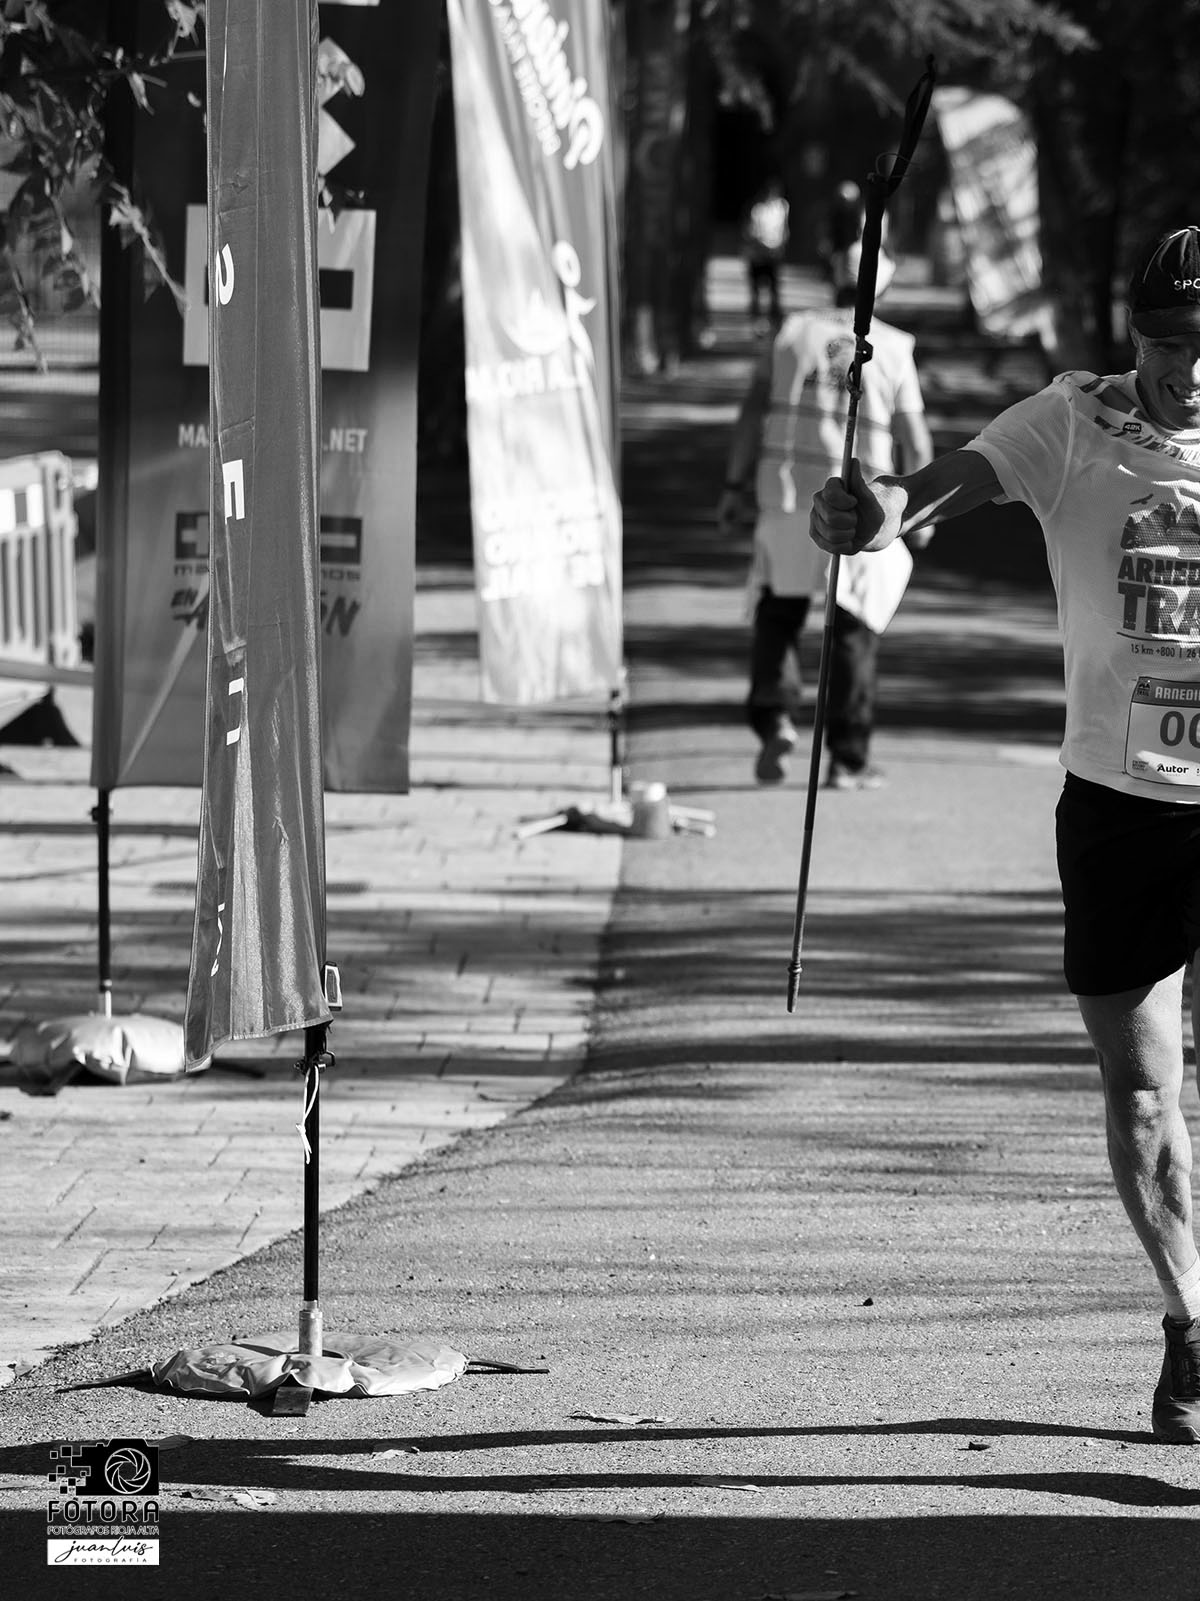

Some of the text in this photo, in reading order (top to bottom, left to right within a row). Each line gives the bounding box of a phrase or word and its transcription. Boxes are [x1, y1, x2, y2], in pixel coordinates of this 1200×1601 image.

[1130, 643, 1140, 653] 15
[1142, 644, 1154, 655] km
[1156, 646, 1176, 657] +800
[1186, 648, 1197, 658] 26
[1157, 763, 1189, 774] Autor
